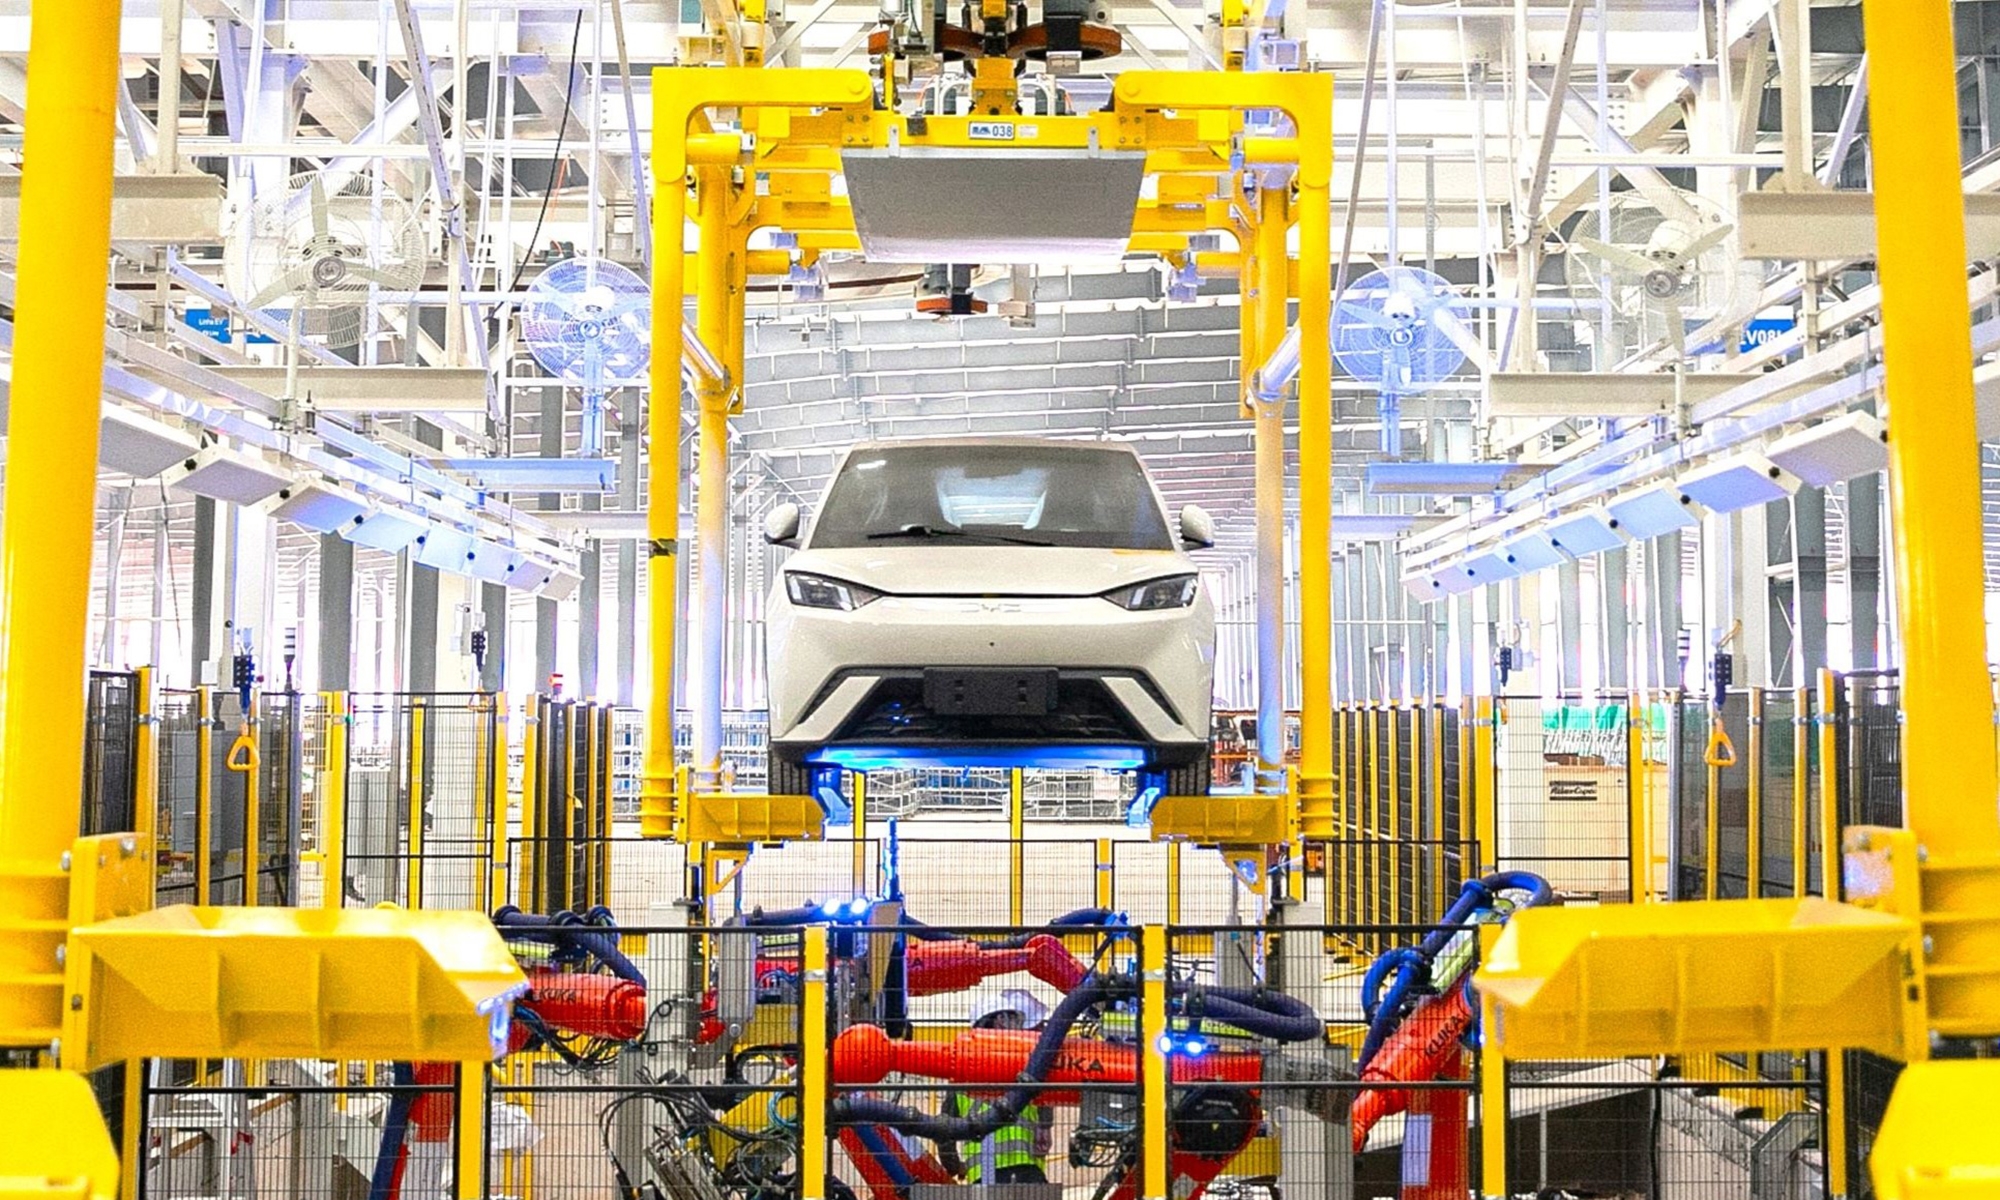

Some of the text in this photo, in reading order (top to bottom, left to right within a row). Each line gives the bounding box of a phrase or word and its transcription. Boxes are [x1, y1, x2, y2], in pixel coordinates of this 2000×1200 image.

[992, 125, 1013, 137] 038
[1425, 1015, 1464, 1057] KUKA
[1051, 1056, 1105, 1073] UKA
